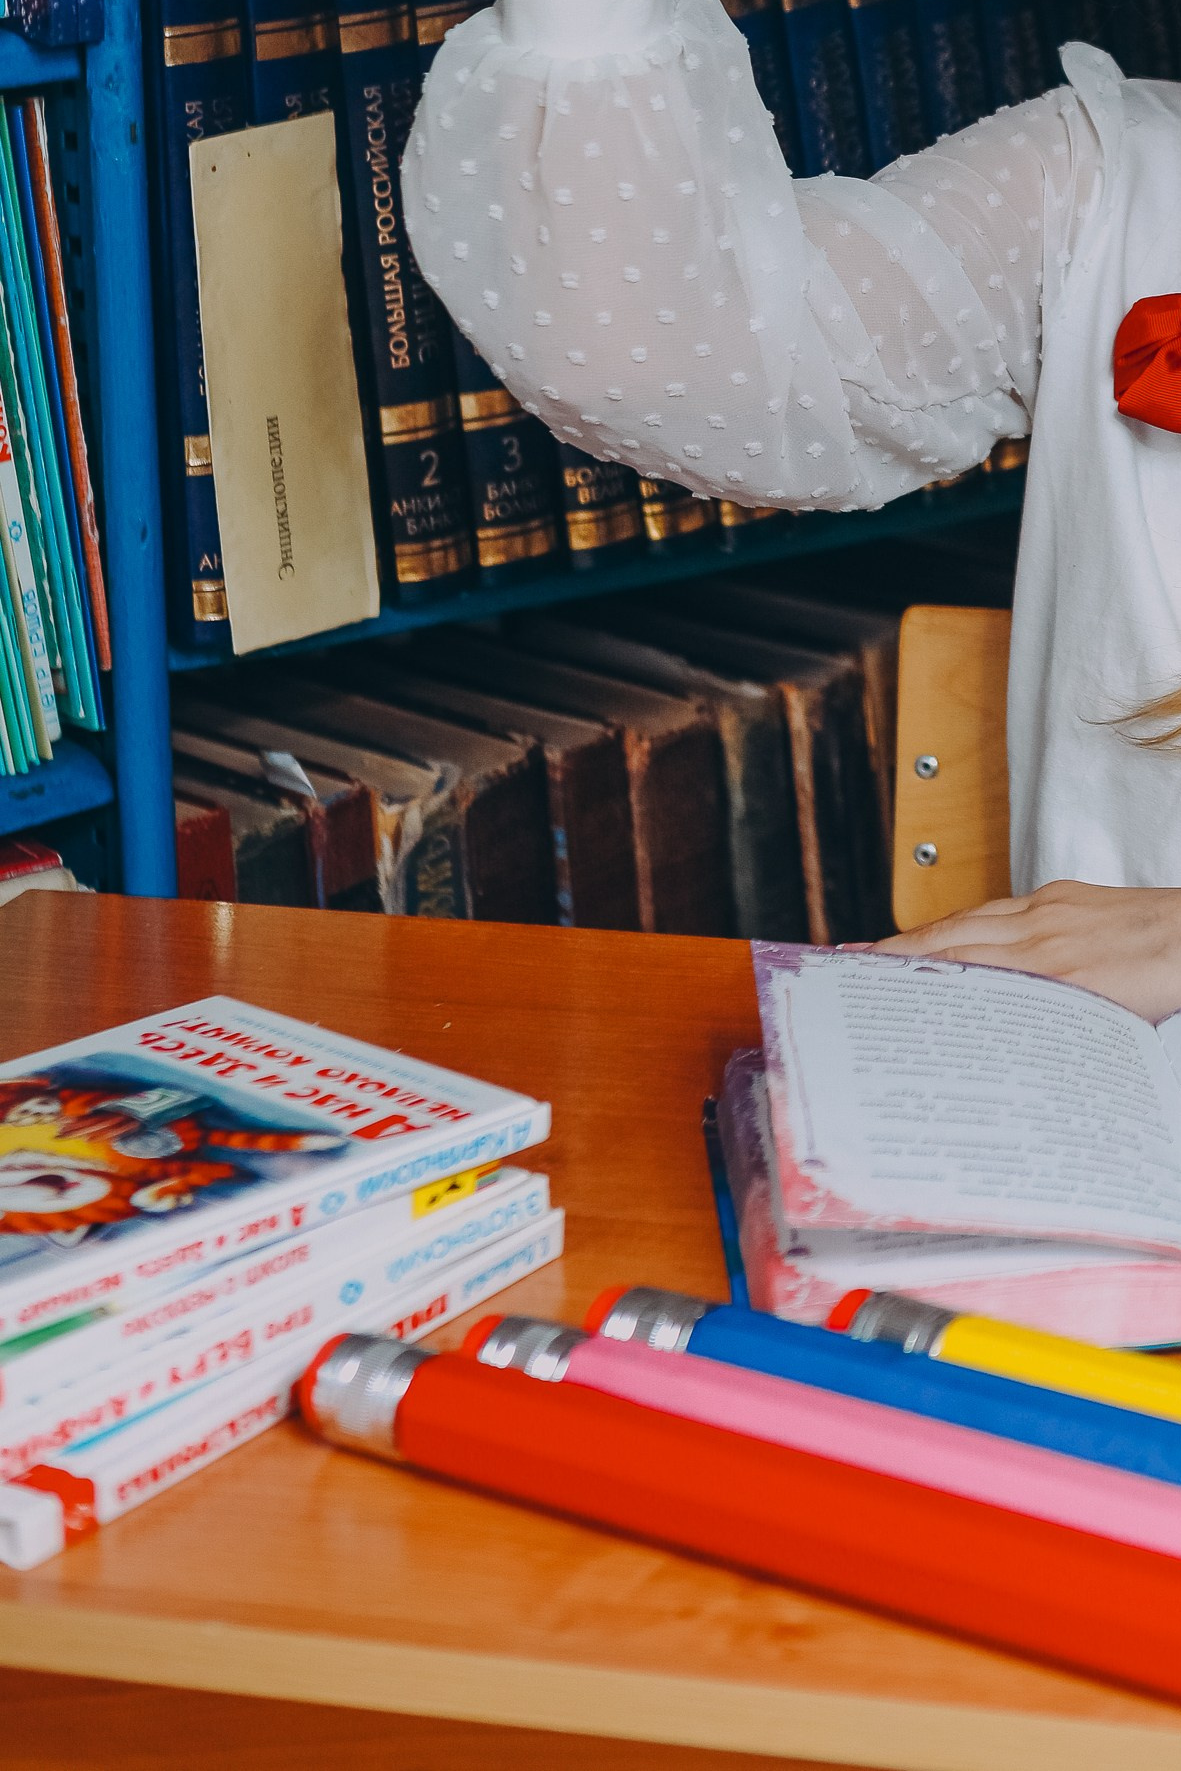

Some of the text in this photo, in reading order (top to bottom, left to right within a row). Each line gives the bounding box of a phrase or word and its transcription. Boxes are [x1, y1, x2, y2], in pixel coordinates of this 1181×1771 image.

[363, 84, 411, 370] БОЛЬШАЯ РОССИЙСКАЯ
[420, 449, 440, 487] 2
[501, 435, 523, 473] 3
[266, 415, 296, 581] Энциклопедии
[158, 1015, 313, 1069] КОРМЯТ!
[138, 1030, 431, 1141] А НАС И ЗДЕСЬ
[315, 1068, 472, 1123] НЕПЛОХО
[168, 1329, 254, 1387] ВЕРУ
